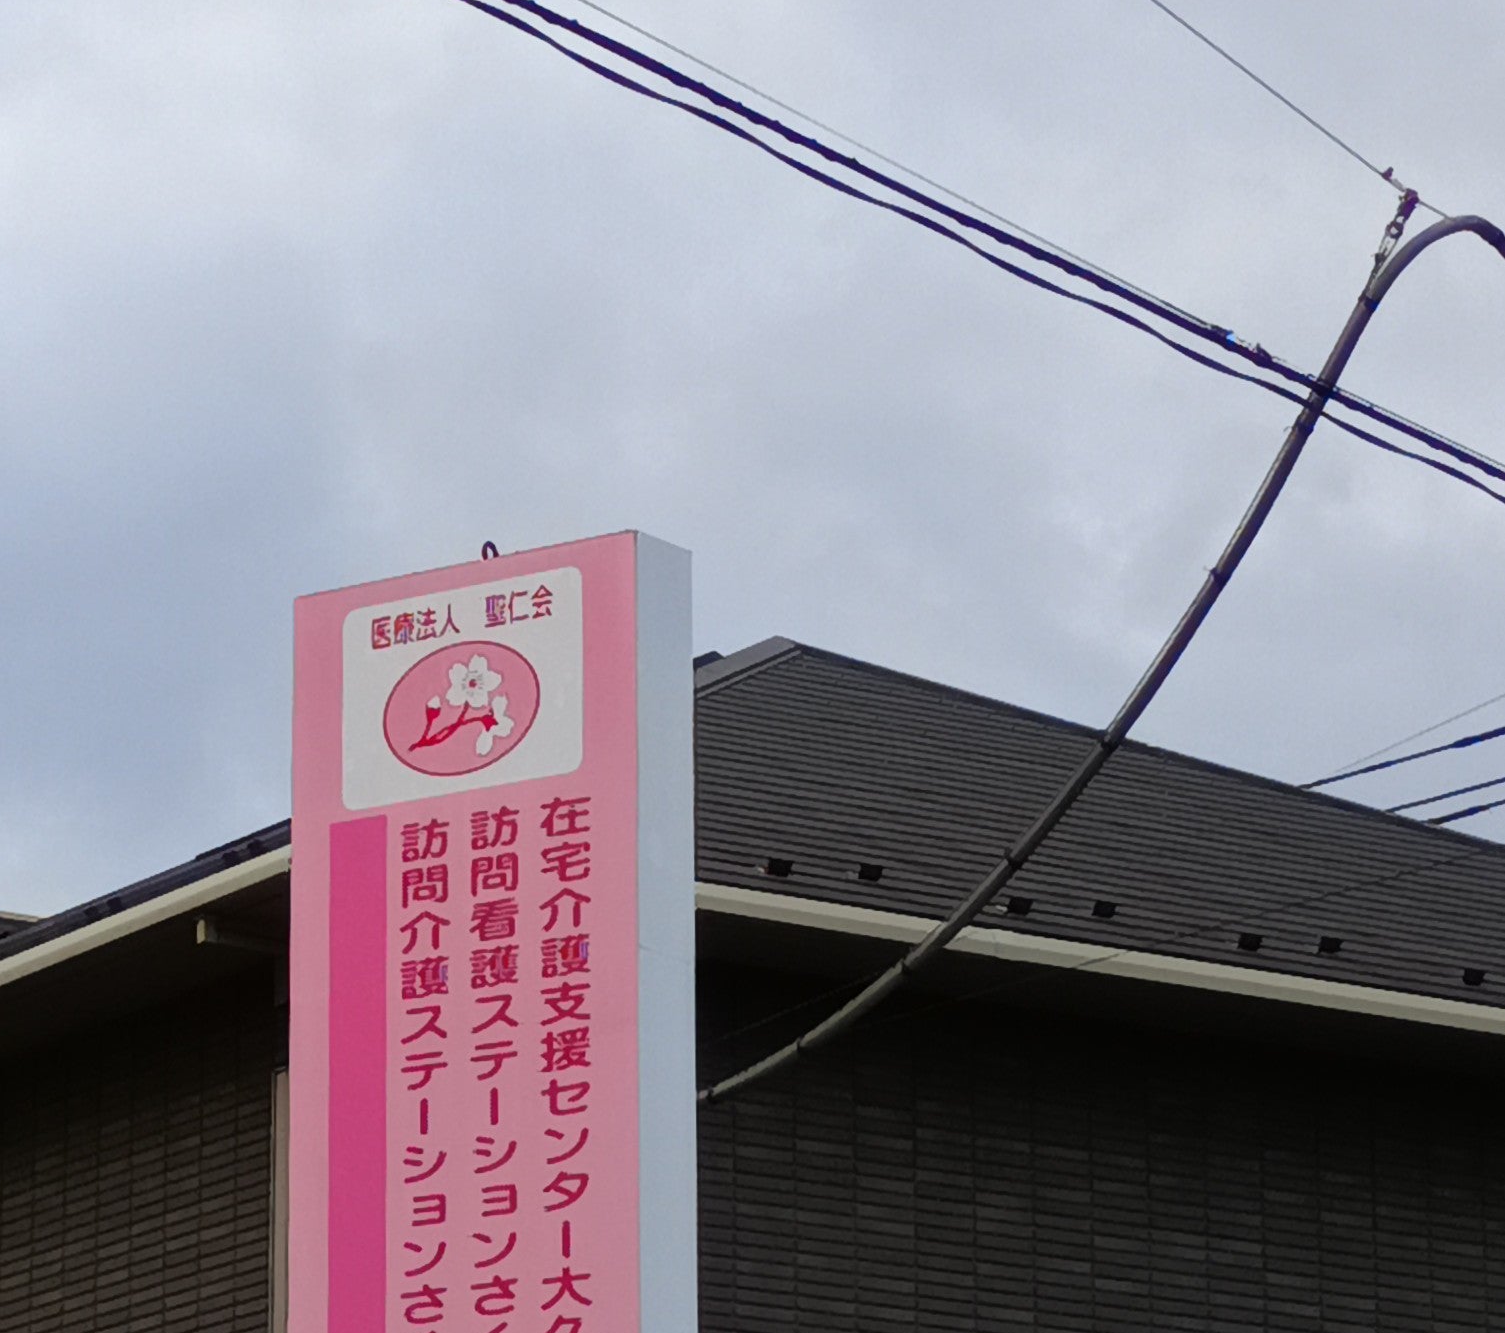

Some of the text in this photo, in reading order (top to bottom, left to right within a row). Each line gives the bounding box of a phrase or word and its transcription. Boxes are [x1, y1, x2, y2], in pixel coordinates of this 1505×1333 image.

[371, 585, 553, 649] 医療法人 聖仁会
